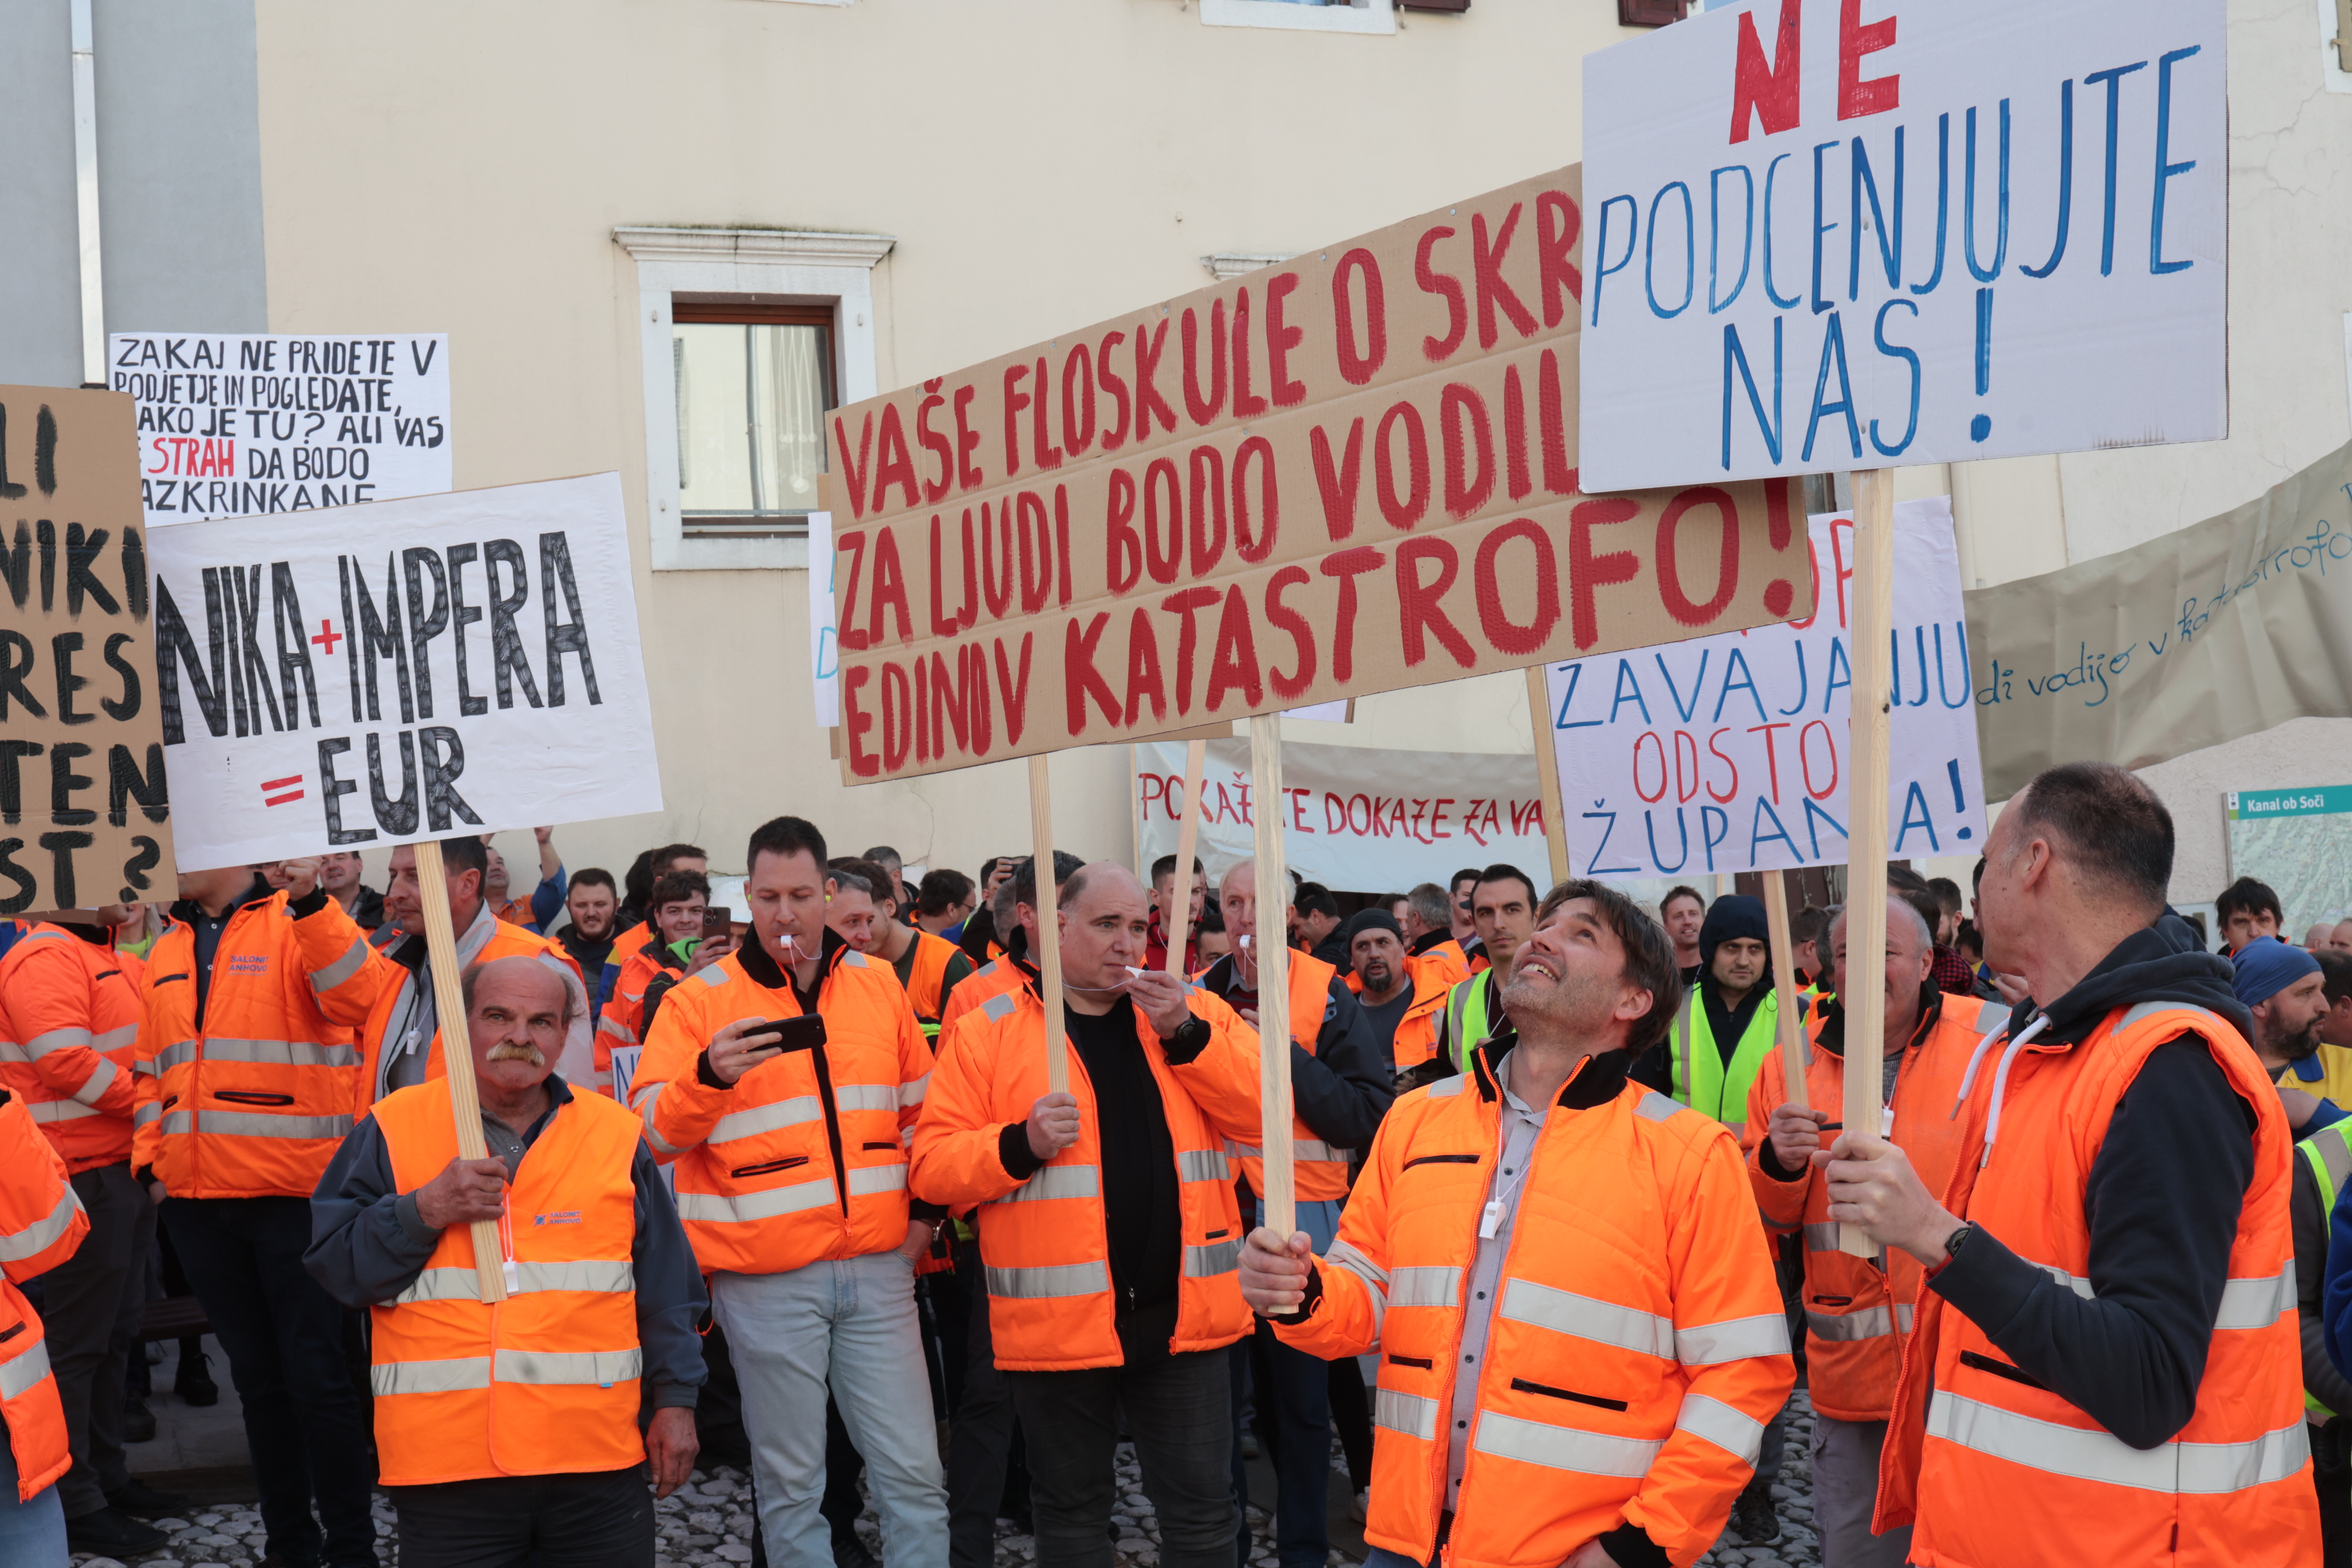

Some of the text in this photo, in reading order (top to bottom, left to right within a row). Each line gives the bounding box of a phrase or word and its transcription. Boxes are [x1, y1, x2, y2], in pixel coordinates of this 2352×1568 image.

[1729, 0, 1900, 144] NE
[1591, 45, 2201, 327] PODCENJUJTE
[116, 339, 437, 376] ZAKAJ NE PRIDETE V
[835, 190, 1582, 518] VAŠE FLOSKULE O SKR
[115, 370, 401, 416] PODJETJE IN POGLEDATE,
[138, 406, 193, 433] AKO
[200, 408, 236, 437] JE
[337, 416, 382, 444] ALI
[394, 416, 443, 448] VAS
[148, 437, 233, 477] STRAH
[248, 447, 285, 479] DA
[293, 446, 369, 480] BODO
[141, 478, 376, 514] AZKRINKANE
[838, 348, 1580, 649] ZA LJUDI BODO VODIL
[2149, 632, 2167, 655] v
[1633, 717, 1850, 805] ODSTO
[317, 726, 485, 845] EUR
[2248, 794, 2324, 812] Kanal ob Soči
[1510, 799, 1547, 837] VA
[230, 955, 269, 963] SALONIT
